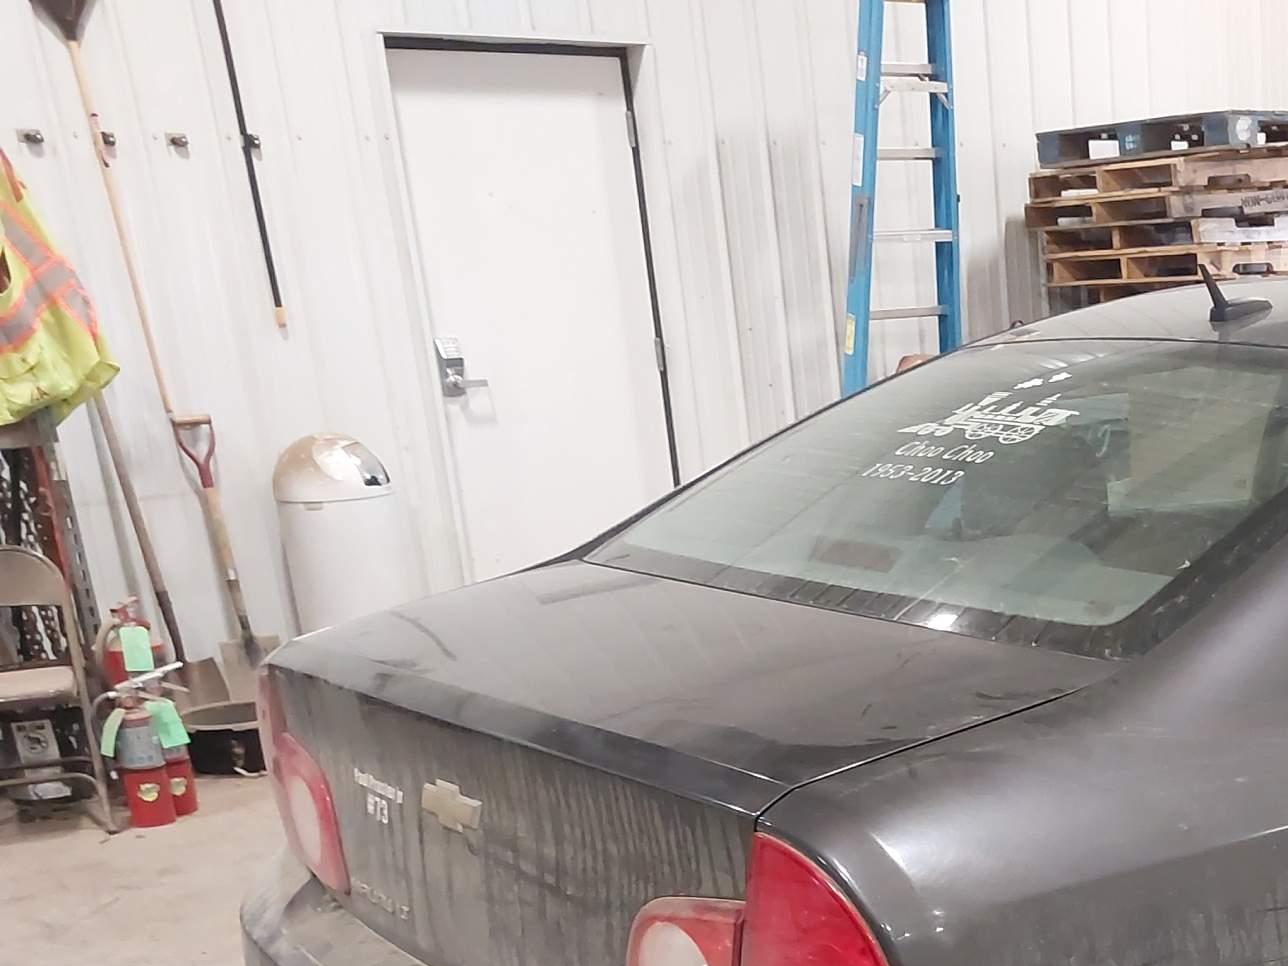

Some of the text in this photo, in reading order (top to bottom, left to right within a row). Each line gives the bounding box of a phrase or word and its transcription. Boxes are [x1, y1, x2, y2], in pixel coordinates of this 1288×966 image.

[895, 440, 994, 464] Choo Choo
[861, 462, 965, 486] 1953-2013
